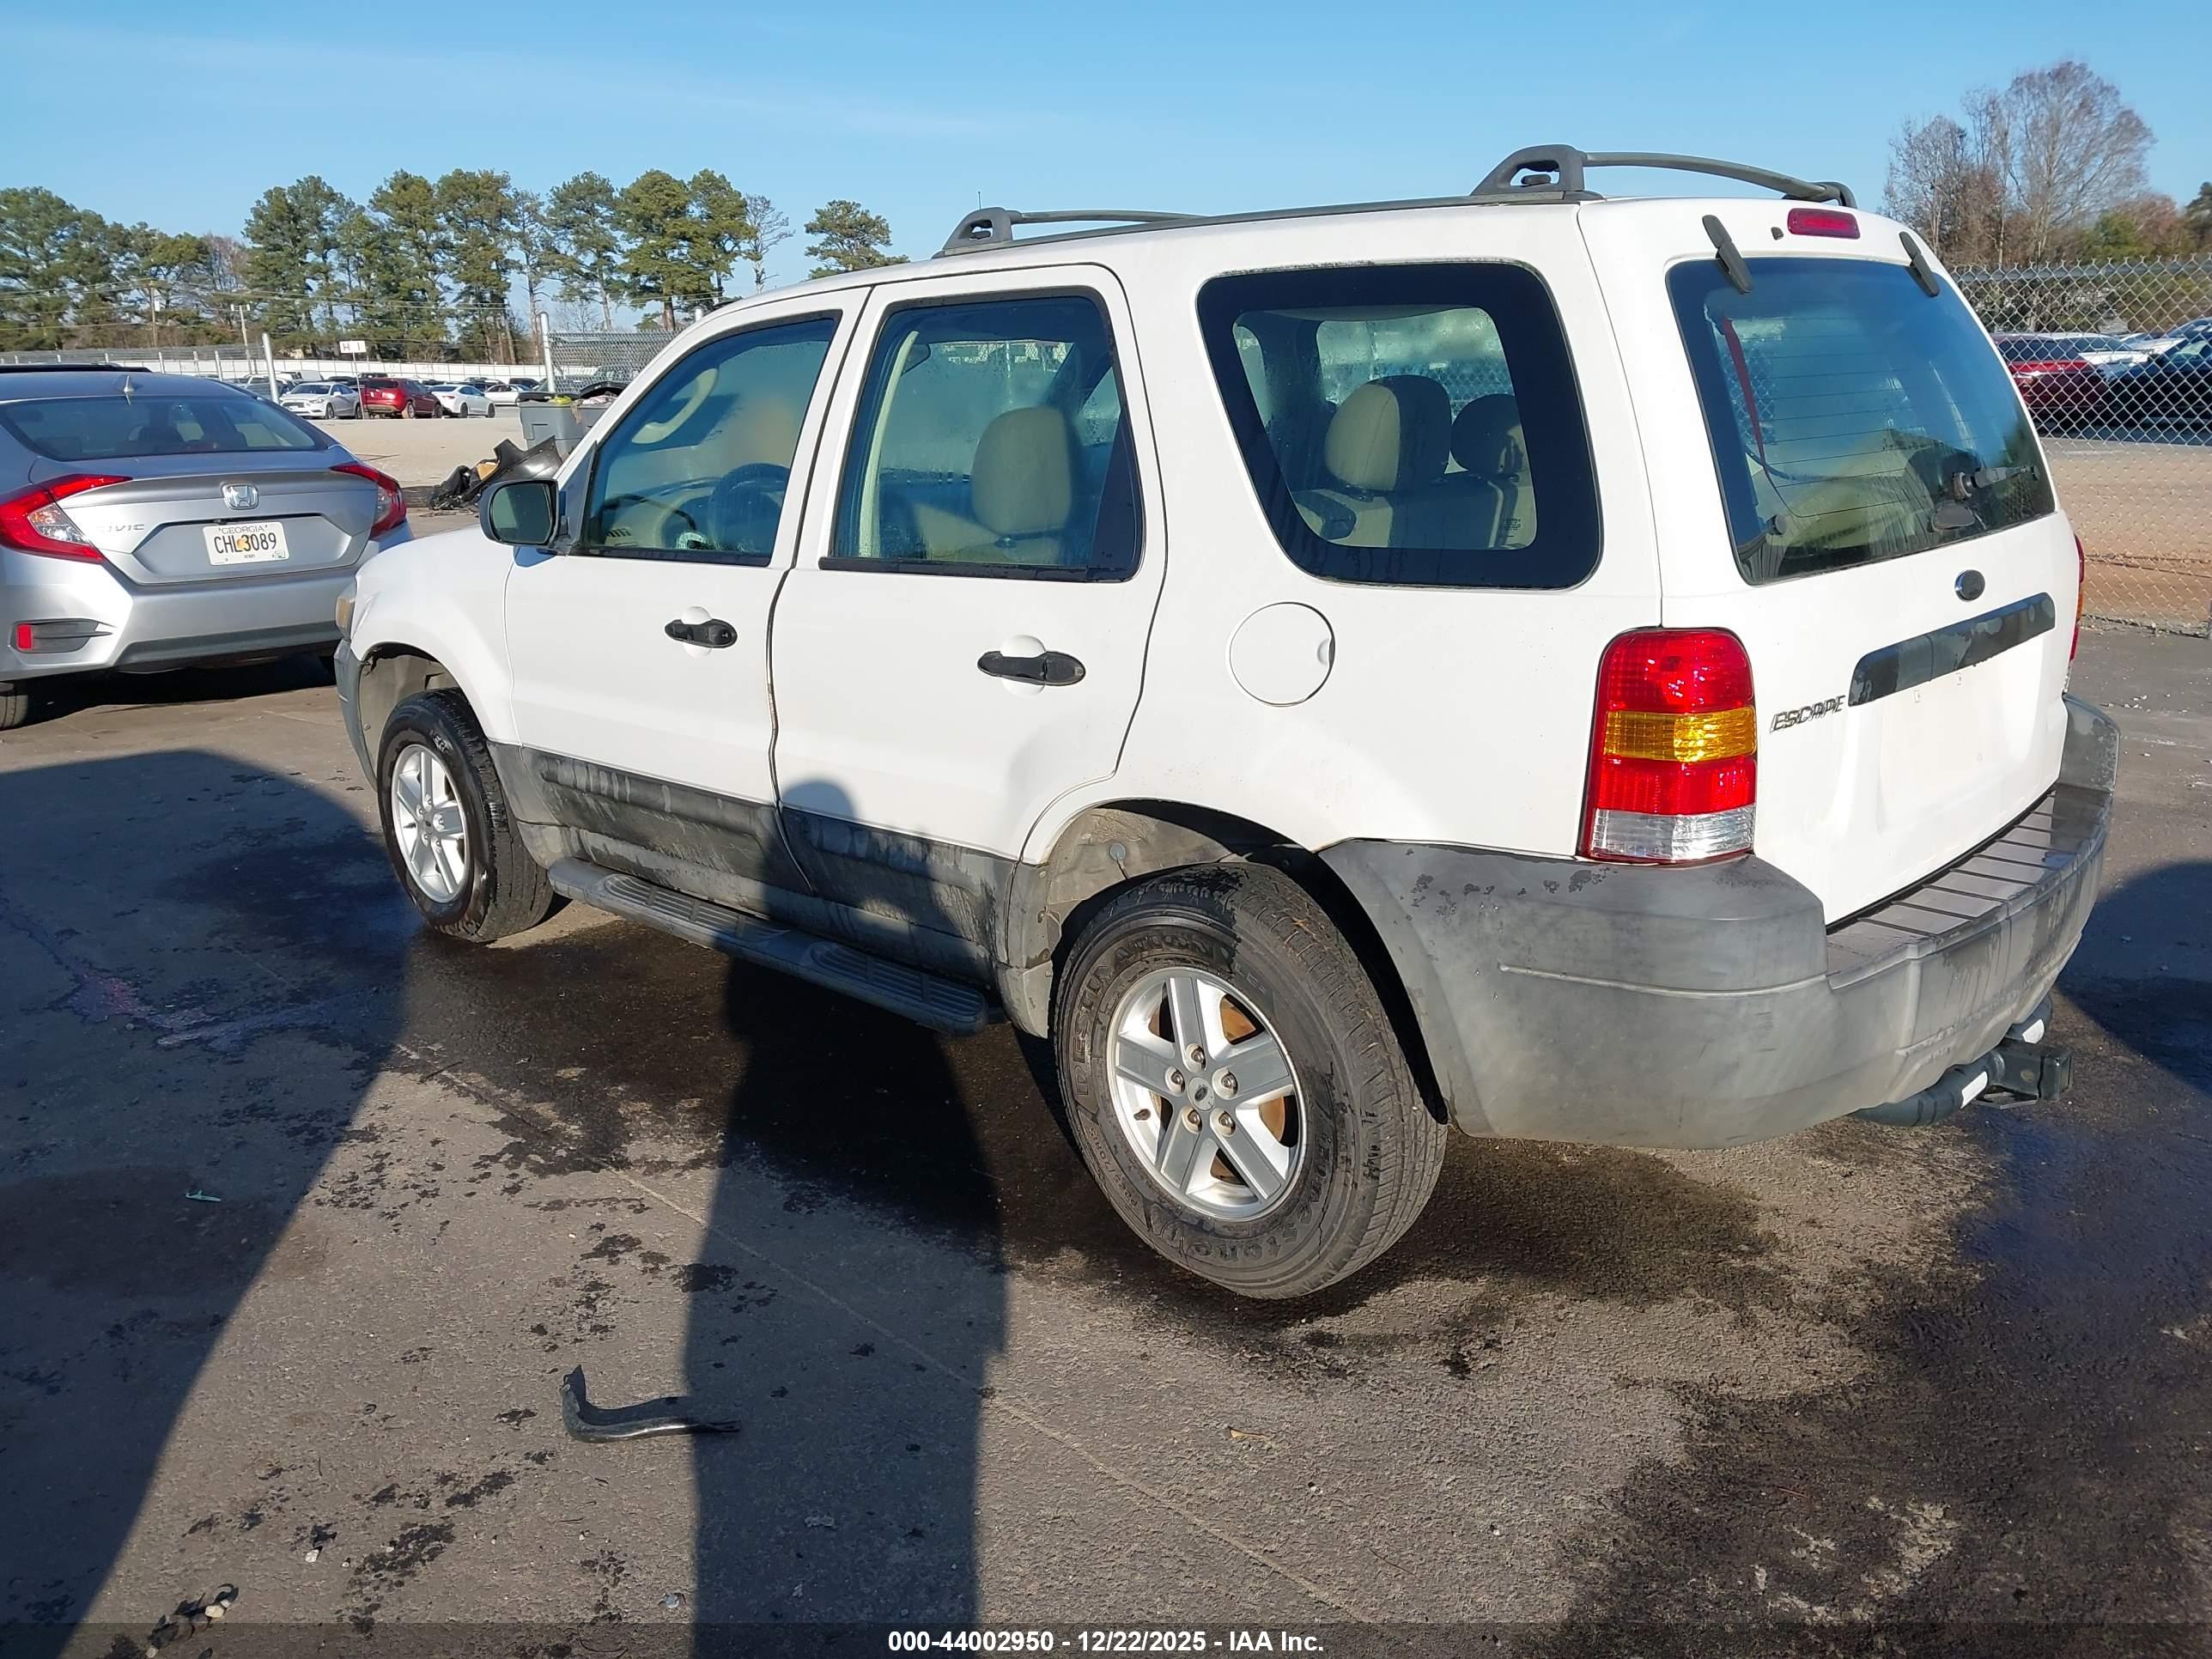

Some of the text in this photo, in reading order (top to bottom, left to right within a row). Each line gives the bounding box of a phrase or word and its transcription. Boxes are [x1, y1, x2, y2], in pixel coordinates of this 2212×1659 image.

[96, 524, 145, 532] IVIC
[221, 525, 265, 535] GEORGIA
[214, 532, 276, 555] CHL3089
[1770, 695, 1846, 734] ESCAPE
